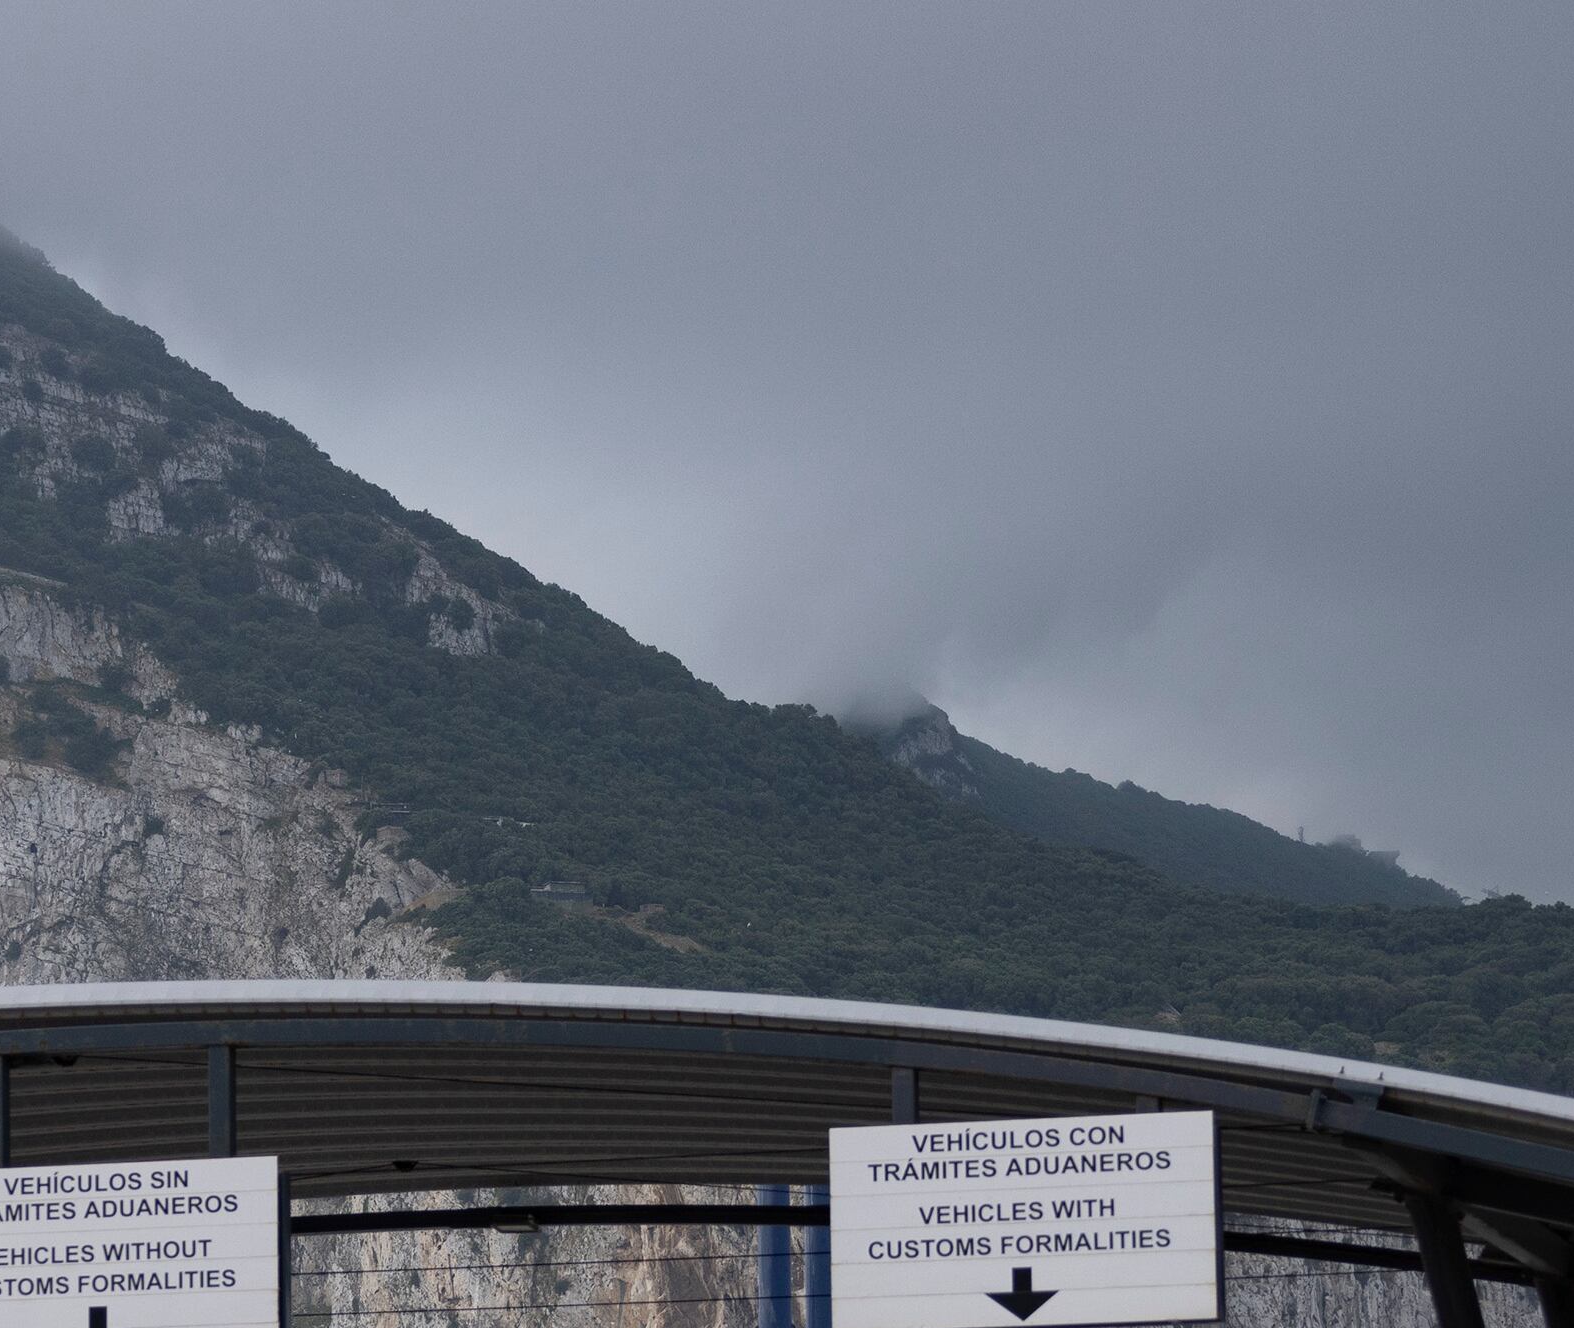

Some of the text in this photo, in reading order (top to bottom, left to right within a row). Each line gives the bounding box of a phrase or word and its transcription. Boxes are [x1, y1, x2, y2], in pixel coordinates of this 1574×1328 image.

[912, 1125, 1126, 1153] VEHÍCULOS CON
[868, 1150, 1172, 1182] TRÁMITES ADUANEROS
[3, 1170, 190, 1196] VEHÍCULOS SIN
[84, 1194, 239, 1219] ADUANEROS
[918, 1198, 1116, 1225] VEHICLES WITH
[102, 1239, 213, 1262] WITHOUT
[868, 1229, 1172, 1260] CUSTOMS FORMALITIES
[78, 1269, 237, 1294] FORMALITIES
